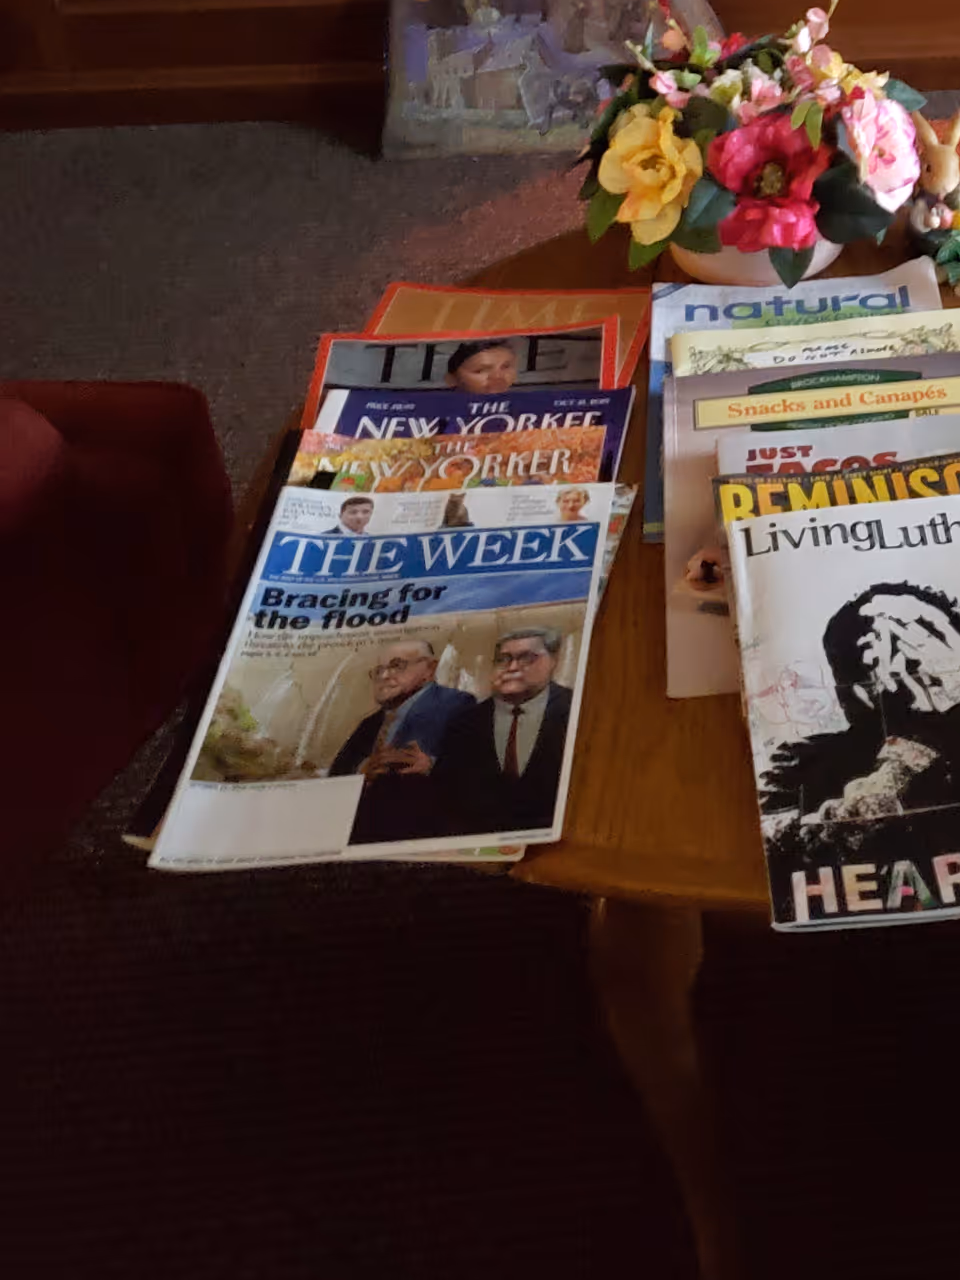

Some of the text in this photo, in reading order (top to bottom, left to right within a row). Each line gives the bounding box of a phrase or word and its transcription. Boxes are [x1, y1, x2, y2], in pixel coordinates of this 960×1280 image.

[684, 285, 912, 323] natural
[468, 400, 511, 415] THE
[726, 393, 807, 420] Snacks
[813, 393, 857, 411] and
[858, 381, 949, 407] Canapés
[355, 414, 441, 439] NEW
[432, 440, 477, 456] THE
[745, 444, 814, 462] JUST
[414, 448, 574, 490] YORKER
[278, 523, 594, 578] THE WEEK
[260, 581, 449, 610] Bracing for
[254, 604, 411, 631] the flood
